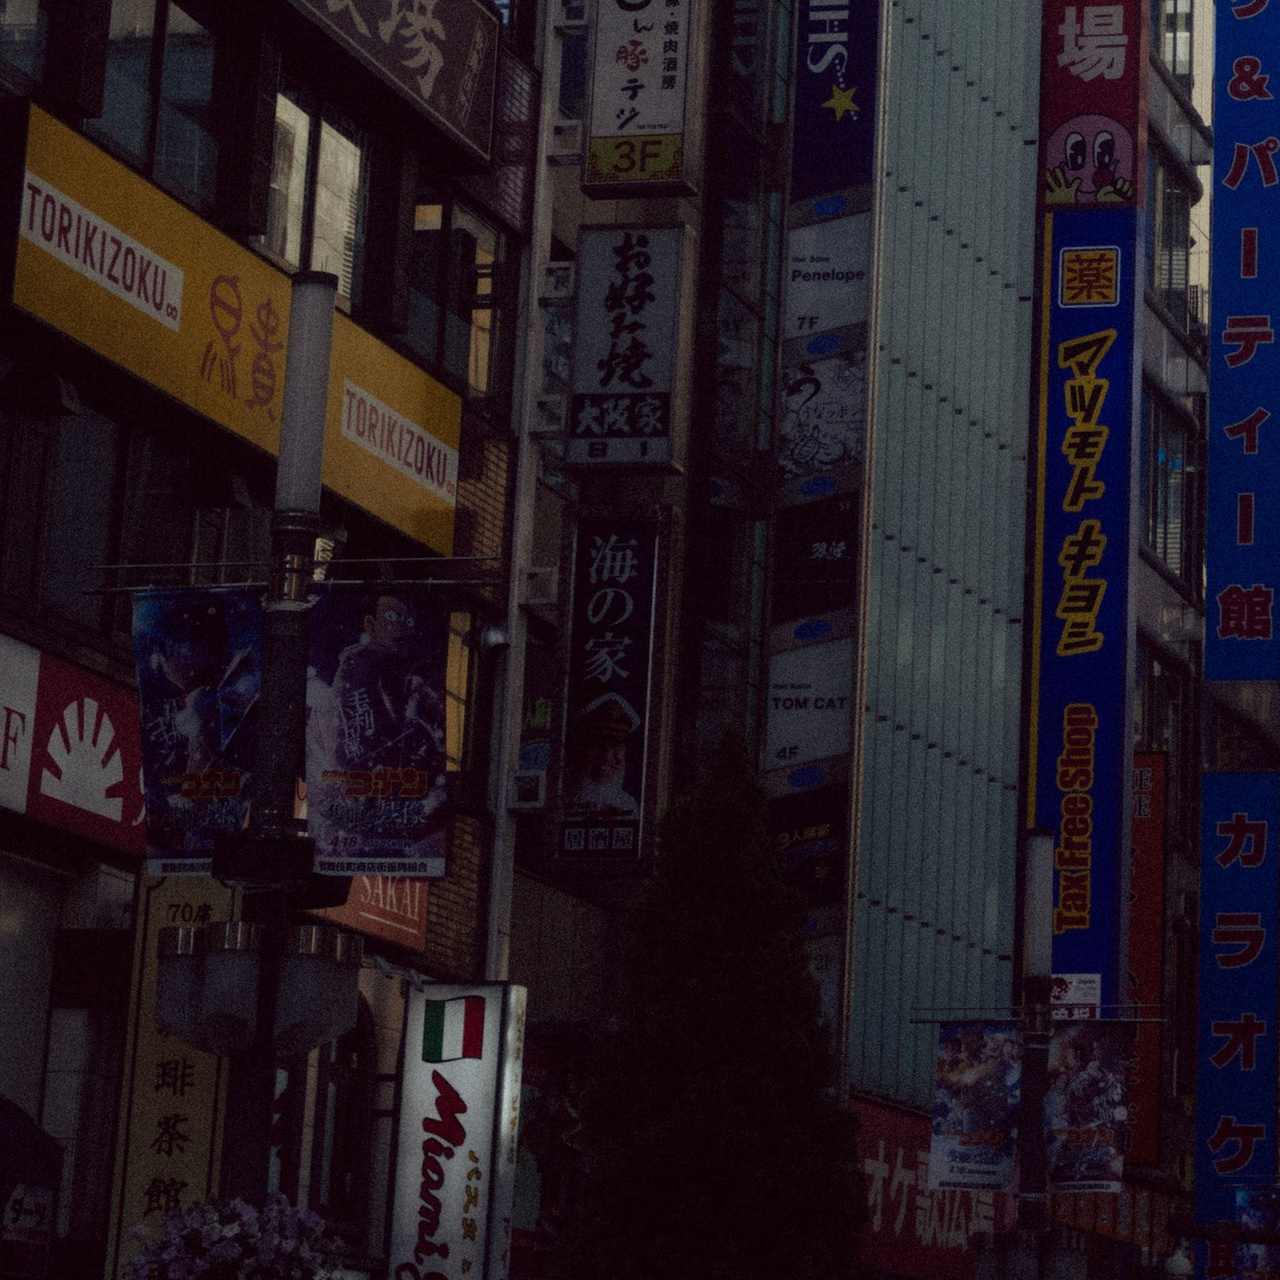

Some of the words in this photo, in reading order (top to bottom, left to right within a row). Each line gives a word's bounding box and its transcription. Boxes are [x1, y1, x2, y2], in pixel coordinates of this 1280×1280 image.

[613, 139, 662, 173] 3F
[27, 182, 166, 311] TORIKIZOKU
[792, 266, 865, 283] Penelope
[1065, 253, 1113, 302] 薬
[797, 315, 819, 330] 7F
[344, 388, 448, 488] TORIKIZOKU
[575, 397, 663, 435] 大阪家
[1056, 327, 1118, 657] マツモトキヨシ
[580, 533, 643, 734] 海の家へ
[773, 697, 809, 711] TOM
[813, 696, 846, 711] CAT
[776, 745, 798, 760] 4F
[1056, 701, 1100, 792] Shop
[1056, 793, 1095, 871] Free
[1054, 871, 1093, 936] Tax
[1206, 812, 1269, 1178] カラオケ
[144, 1026, 195, 1218] 琲茶館
[415, 1069, 467, 1265] Miami
